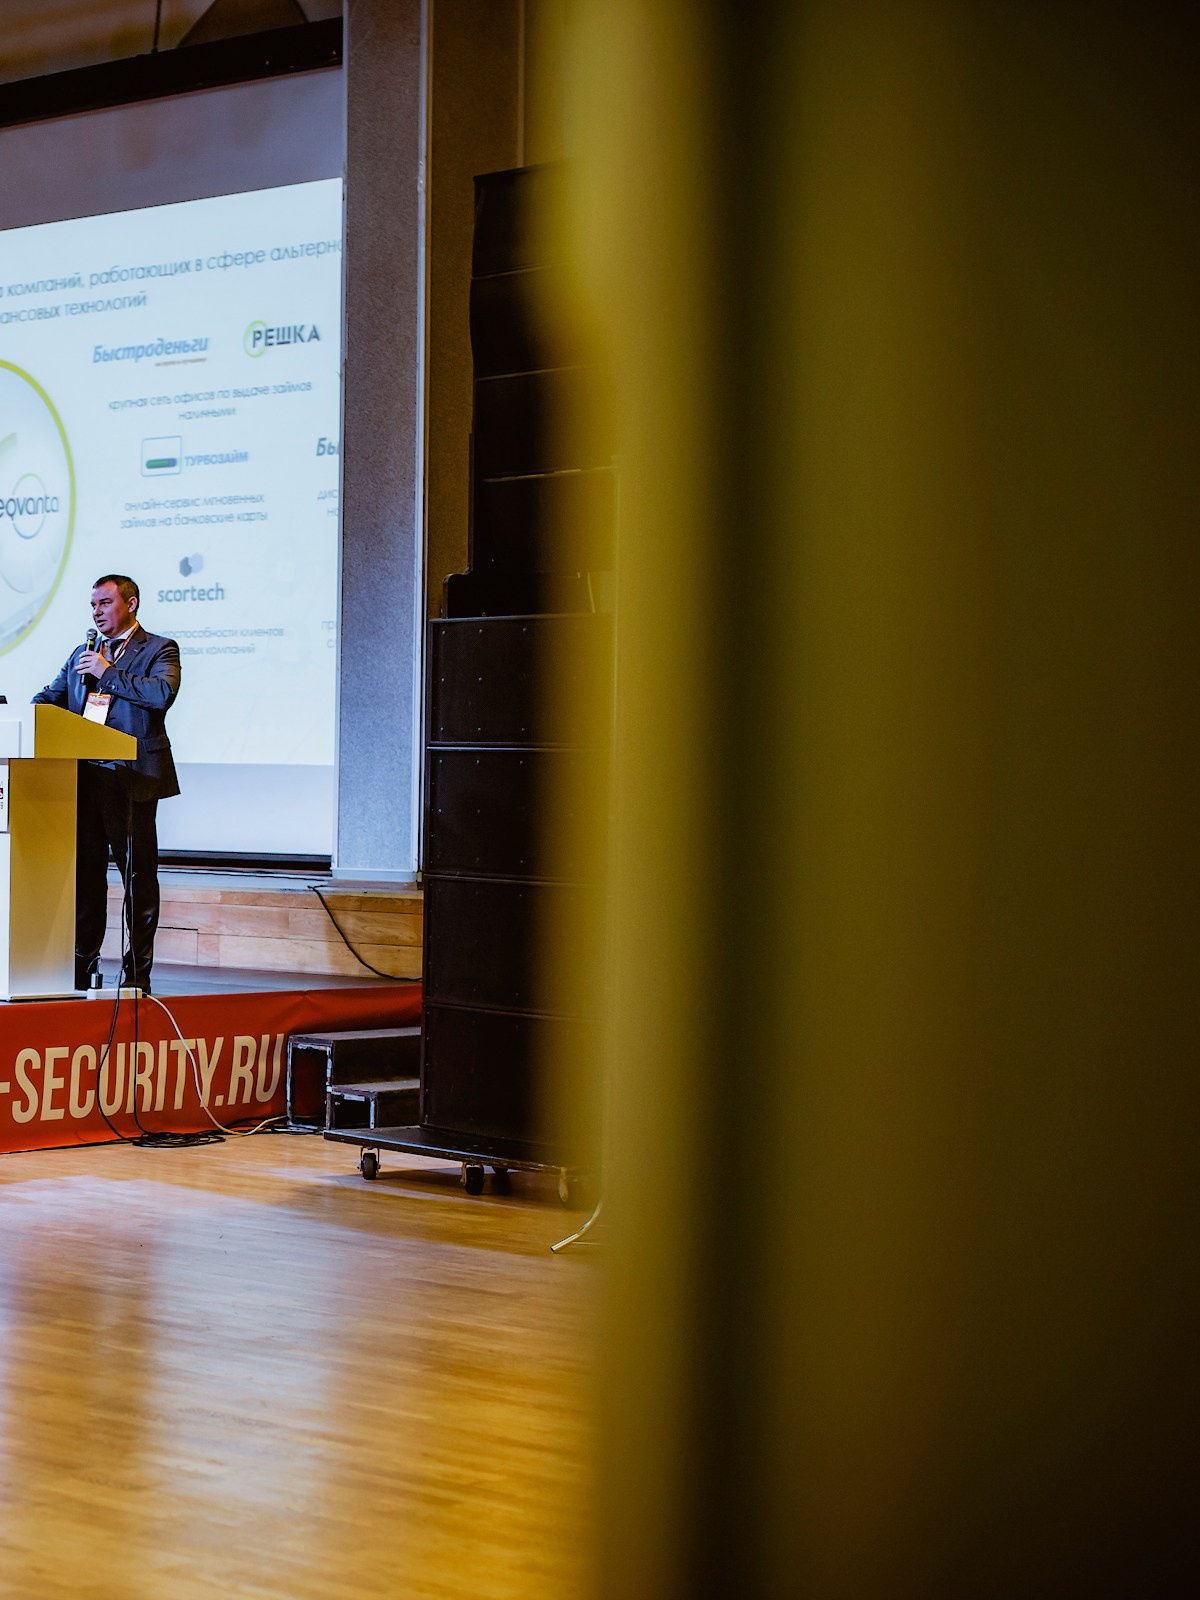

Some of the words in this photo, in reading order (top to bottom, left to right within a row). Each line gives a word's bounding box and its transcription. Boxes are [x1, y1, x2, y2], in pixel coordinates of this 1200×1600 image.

[7, 272, 85, 297] компаний,
[89, 259, 191, 289] работающих
[195, 258, 203, 272] в
[207, 249, 266, 271] сфере
[65, 290, 147, 317] технологий
[252, 325, 321, 348] РЕШКА
[92, 337, 209, 363] Быстроденьги
[109, 396, 148, 411] крупная
[150, 394, 172, 406] сеть
[174, 389, 215, 404] офисов
[217, 389, 230, 399] по
[184, 450, 249, 467] ТУРБОЗАЙМ
[157, 582, 225, 603] scortech
